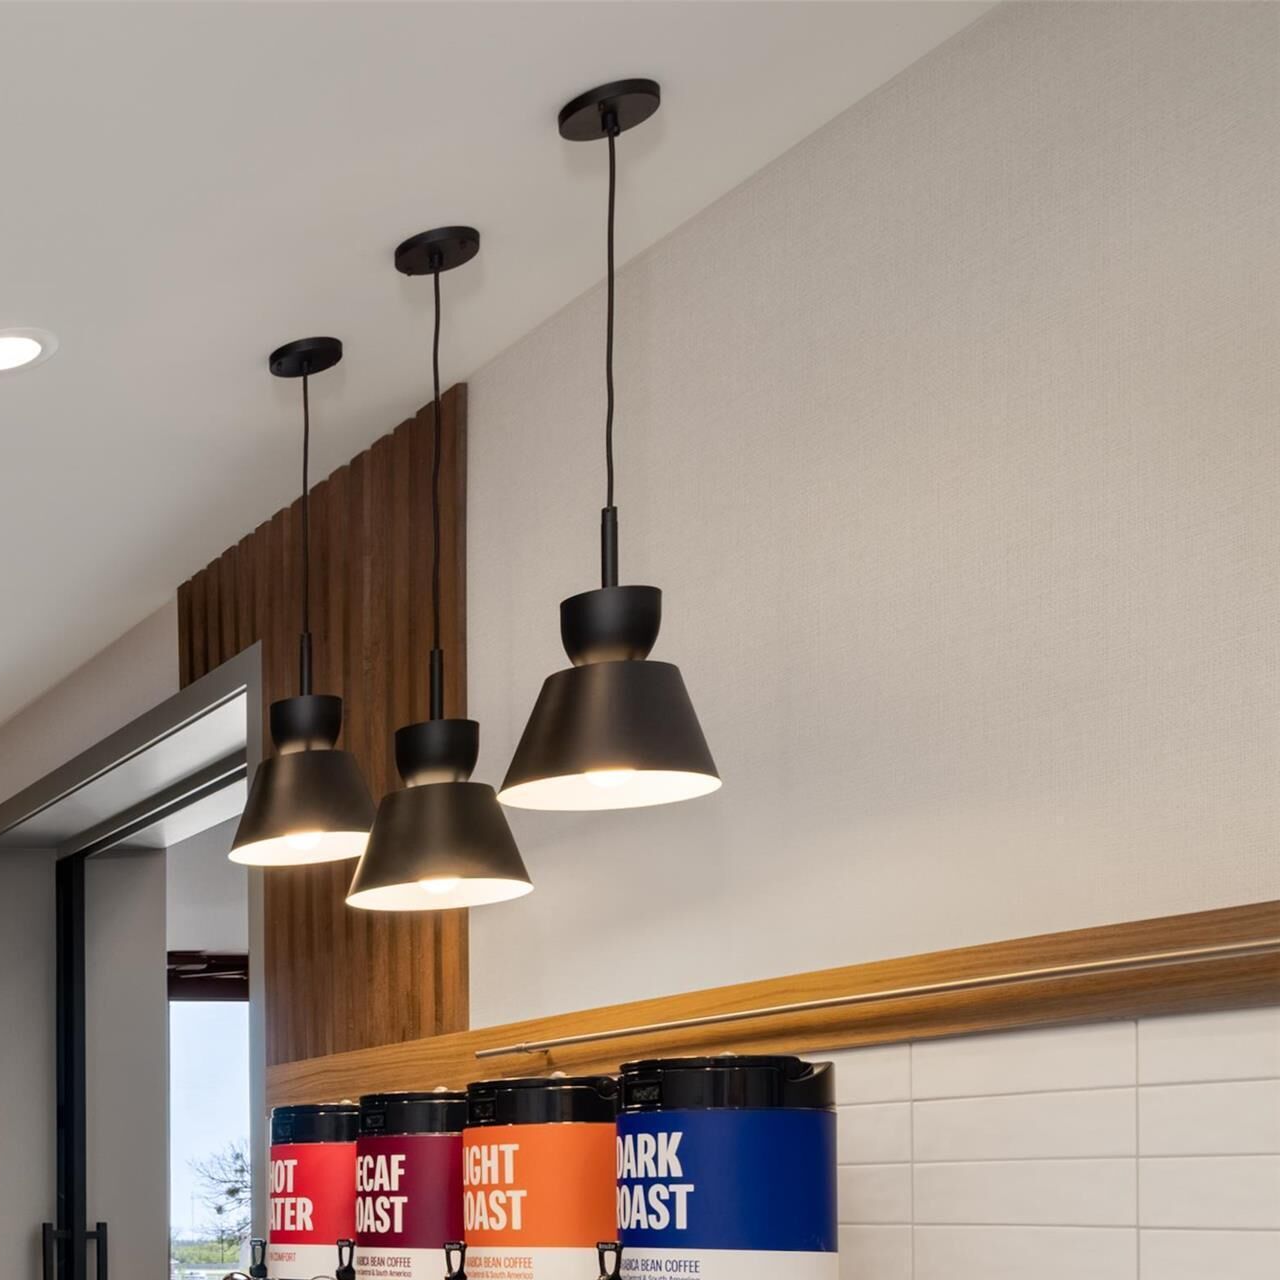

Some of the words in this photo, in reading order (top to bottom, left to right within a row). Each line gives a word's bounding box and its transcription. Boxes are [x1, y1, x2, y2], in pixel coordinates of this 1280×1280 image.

[355, 1154, 407, 1192] ECAF
[270, 1197, 314, 1231] ATER
[355, 1196, 408, 1234] OAST
[464, 1190, 527, 1231] OAST
[387, 1256, 412, 1268] COFFEE
[503, 1257, 533, 1269] COFFEE
[641, 1258, 662, 1272] BEAN
[665, 1259, 701, 1273] COFFEE
